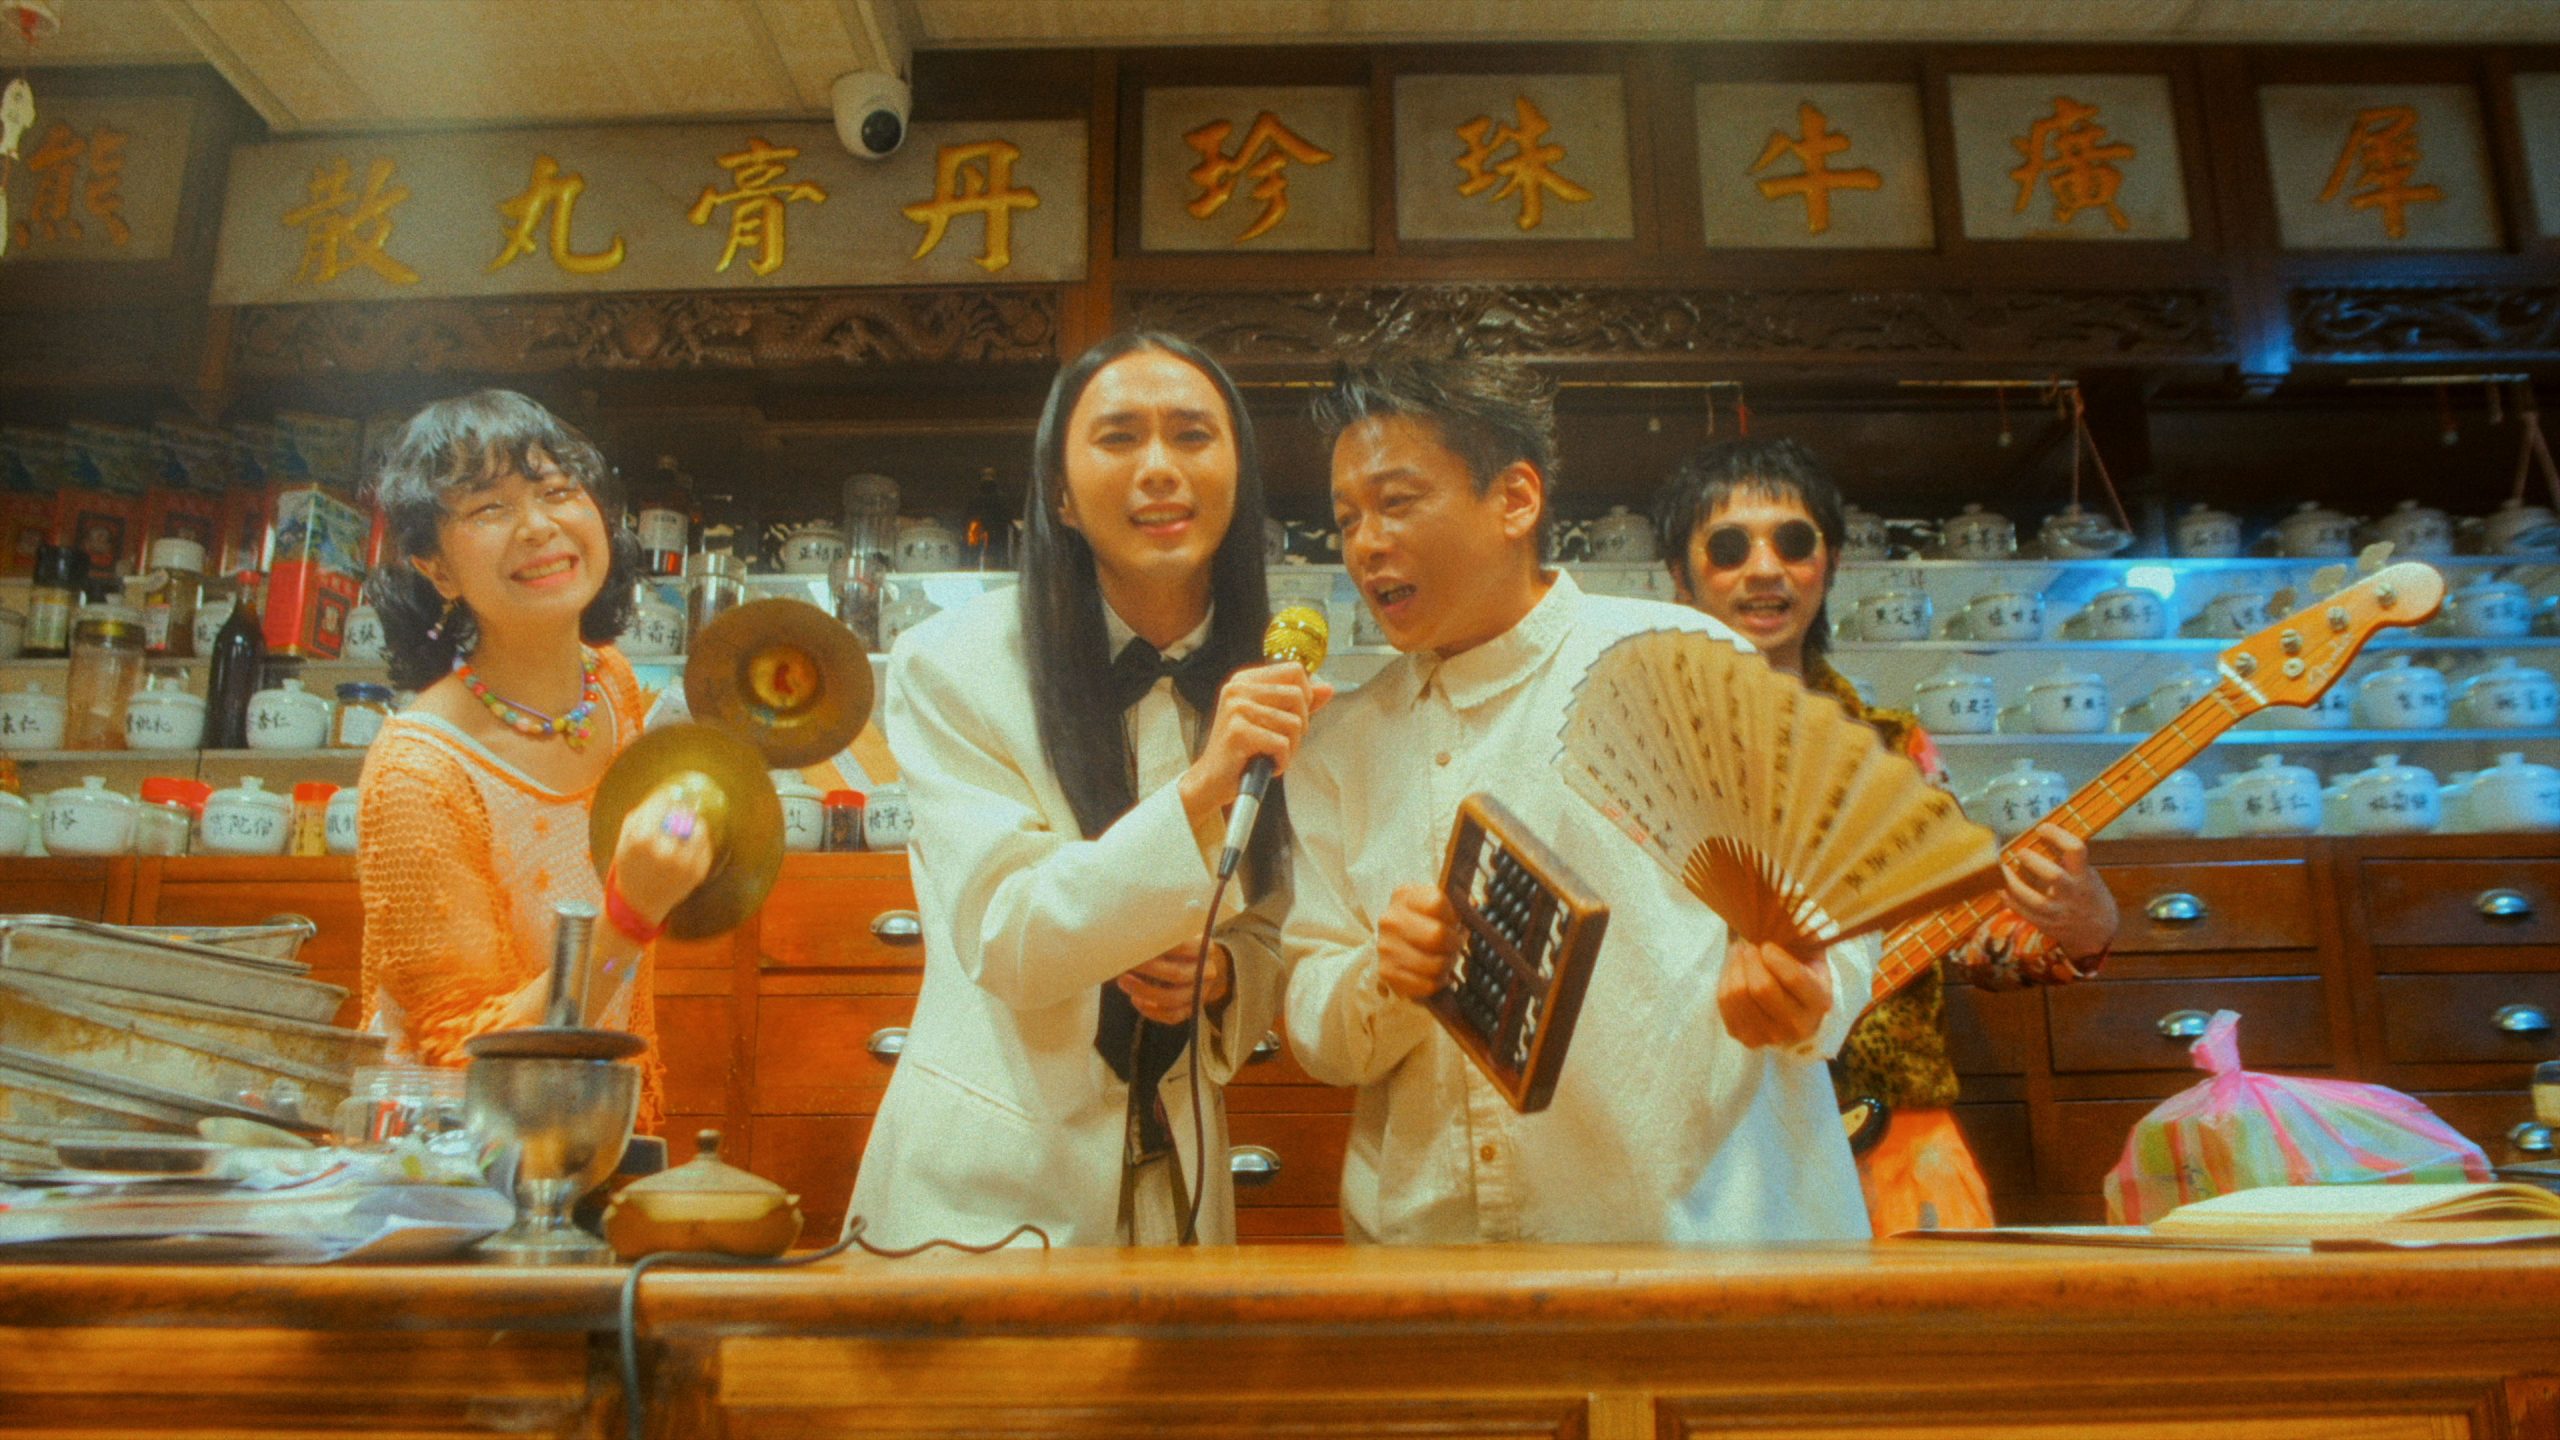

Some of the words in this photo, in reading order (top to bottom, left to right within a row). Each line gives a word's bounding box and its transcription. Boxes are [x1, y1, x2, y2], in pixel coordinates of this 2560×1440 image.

[15, 122, 131, 250] 熊
[1182, 109, 1335, 242] 珍
[1455, 94, 1593, 231] 珠
[1746, 102, 1882, 236] 牛
[2315, 103, 2446, 238] 犀
